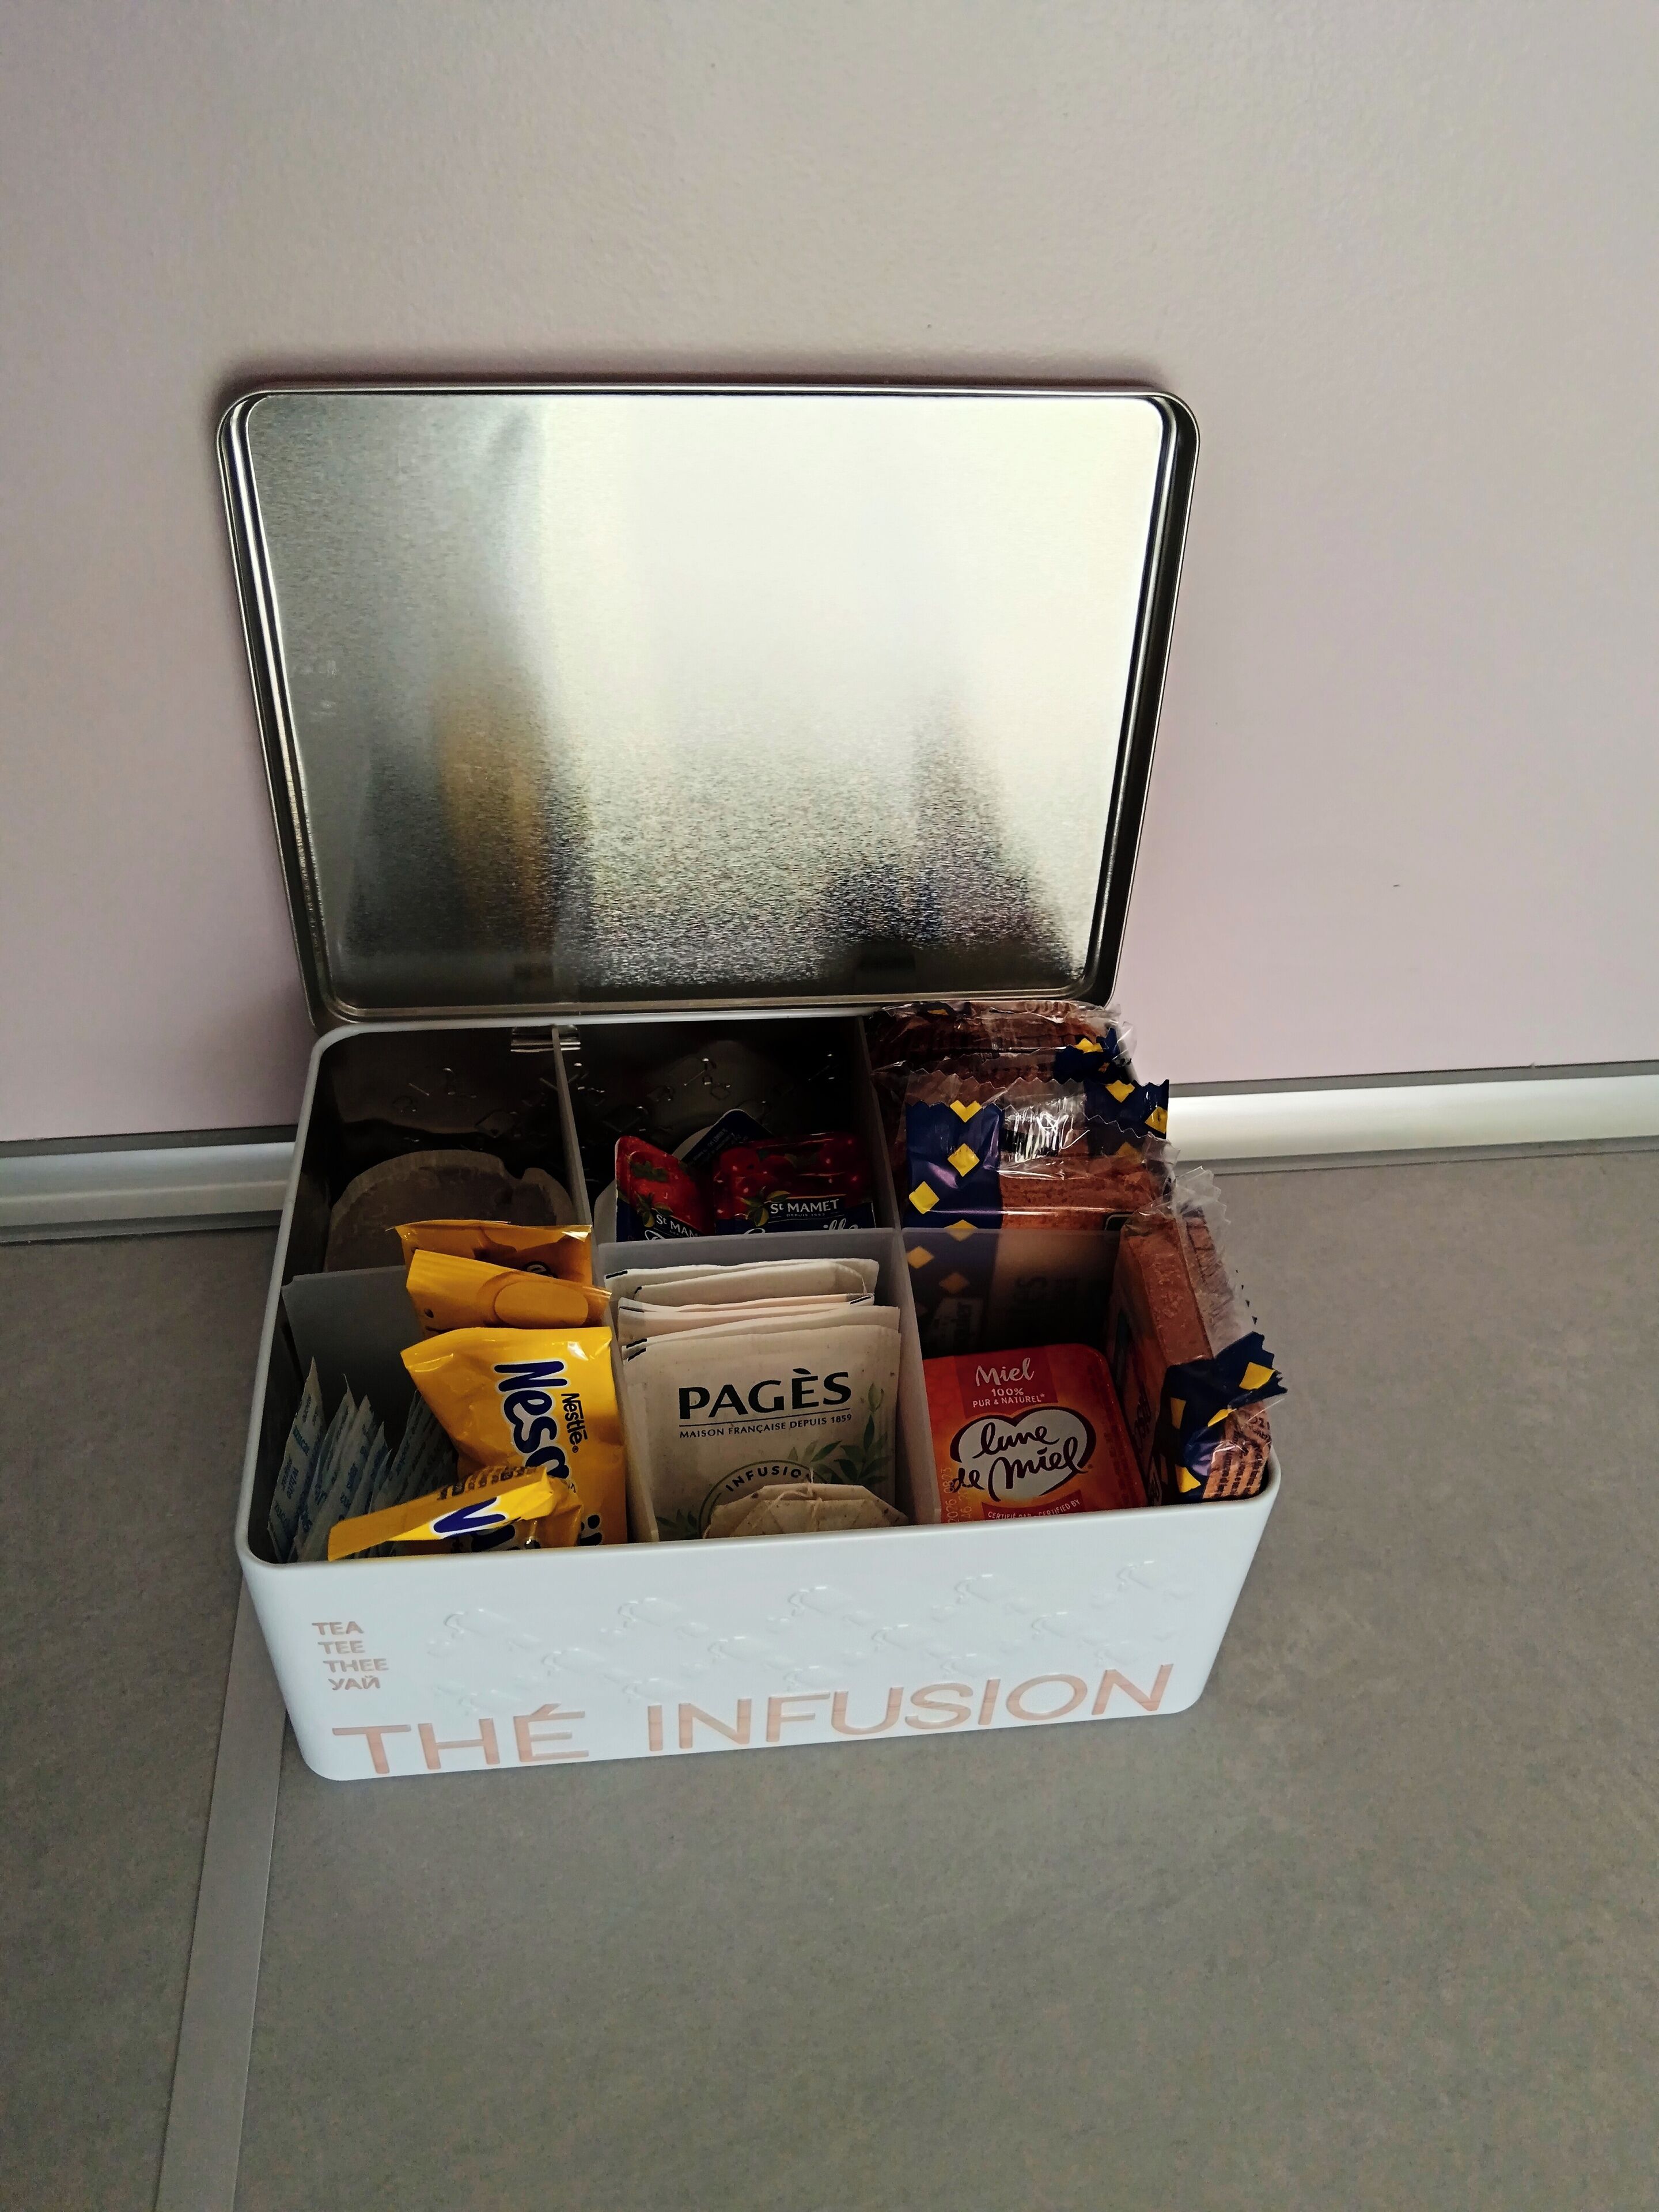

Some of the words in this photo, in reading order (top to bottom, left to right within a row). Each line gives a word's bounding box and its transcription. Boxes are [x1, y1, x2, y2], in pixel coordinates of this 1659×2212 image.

[770, 1203, 784, 1214] St
[787, 1199, 839, 1213] MAMET
[656, 1214, 667, 1225] St
[670, 1221, 701, 1238] MAM
[975, 1357, 1035, 1387] Miel
[679, 1368, 851, 1419] PAGÈS
[991, 1388, 1024, 1397] 100%
[972, 1399, 991, 1408] PUR
[679, 1428, 725, 1438] MAISON
[728, 1422, 786, 1435] FRANÇAISE
[790, 1417, 827, 1429] DEPUIS
[831, 1414, 852, 1423] 1859
[972, 1422, 1060, 1459] lune
[952, 1467, 985, 1493] de
[1071, 1498, 1081, 1508] BY
[312, 1621, 365, 1635] TEA
[317, 1640, 366, 1654] TEE
[323, 1658, 389, 1673] THEE
[332, 1702, 589, 1774] THÉ
[646, 1663, 1175, 1752] INFUSION
